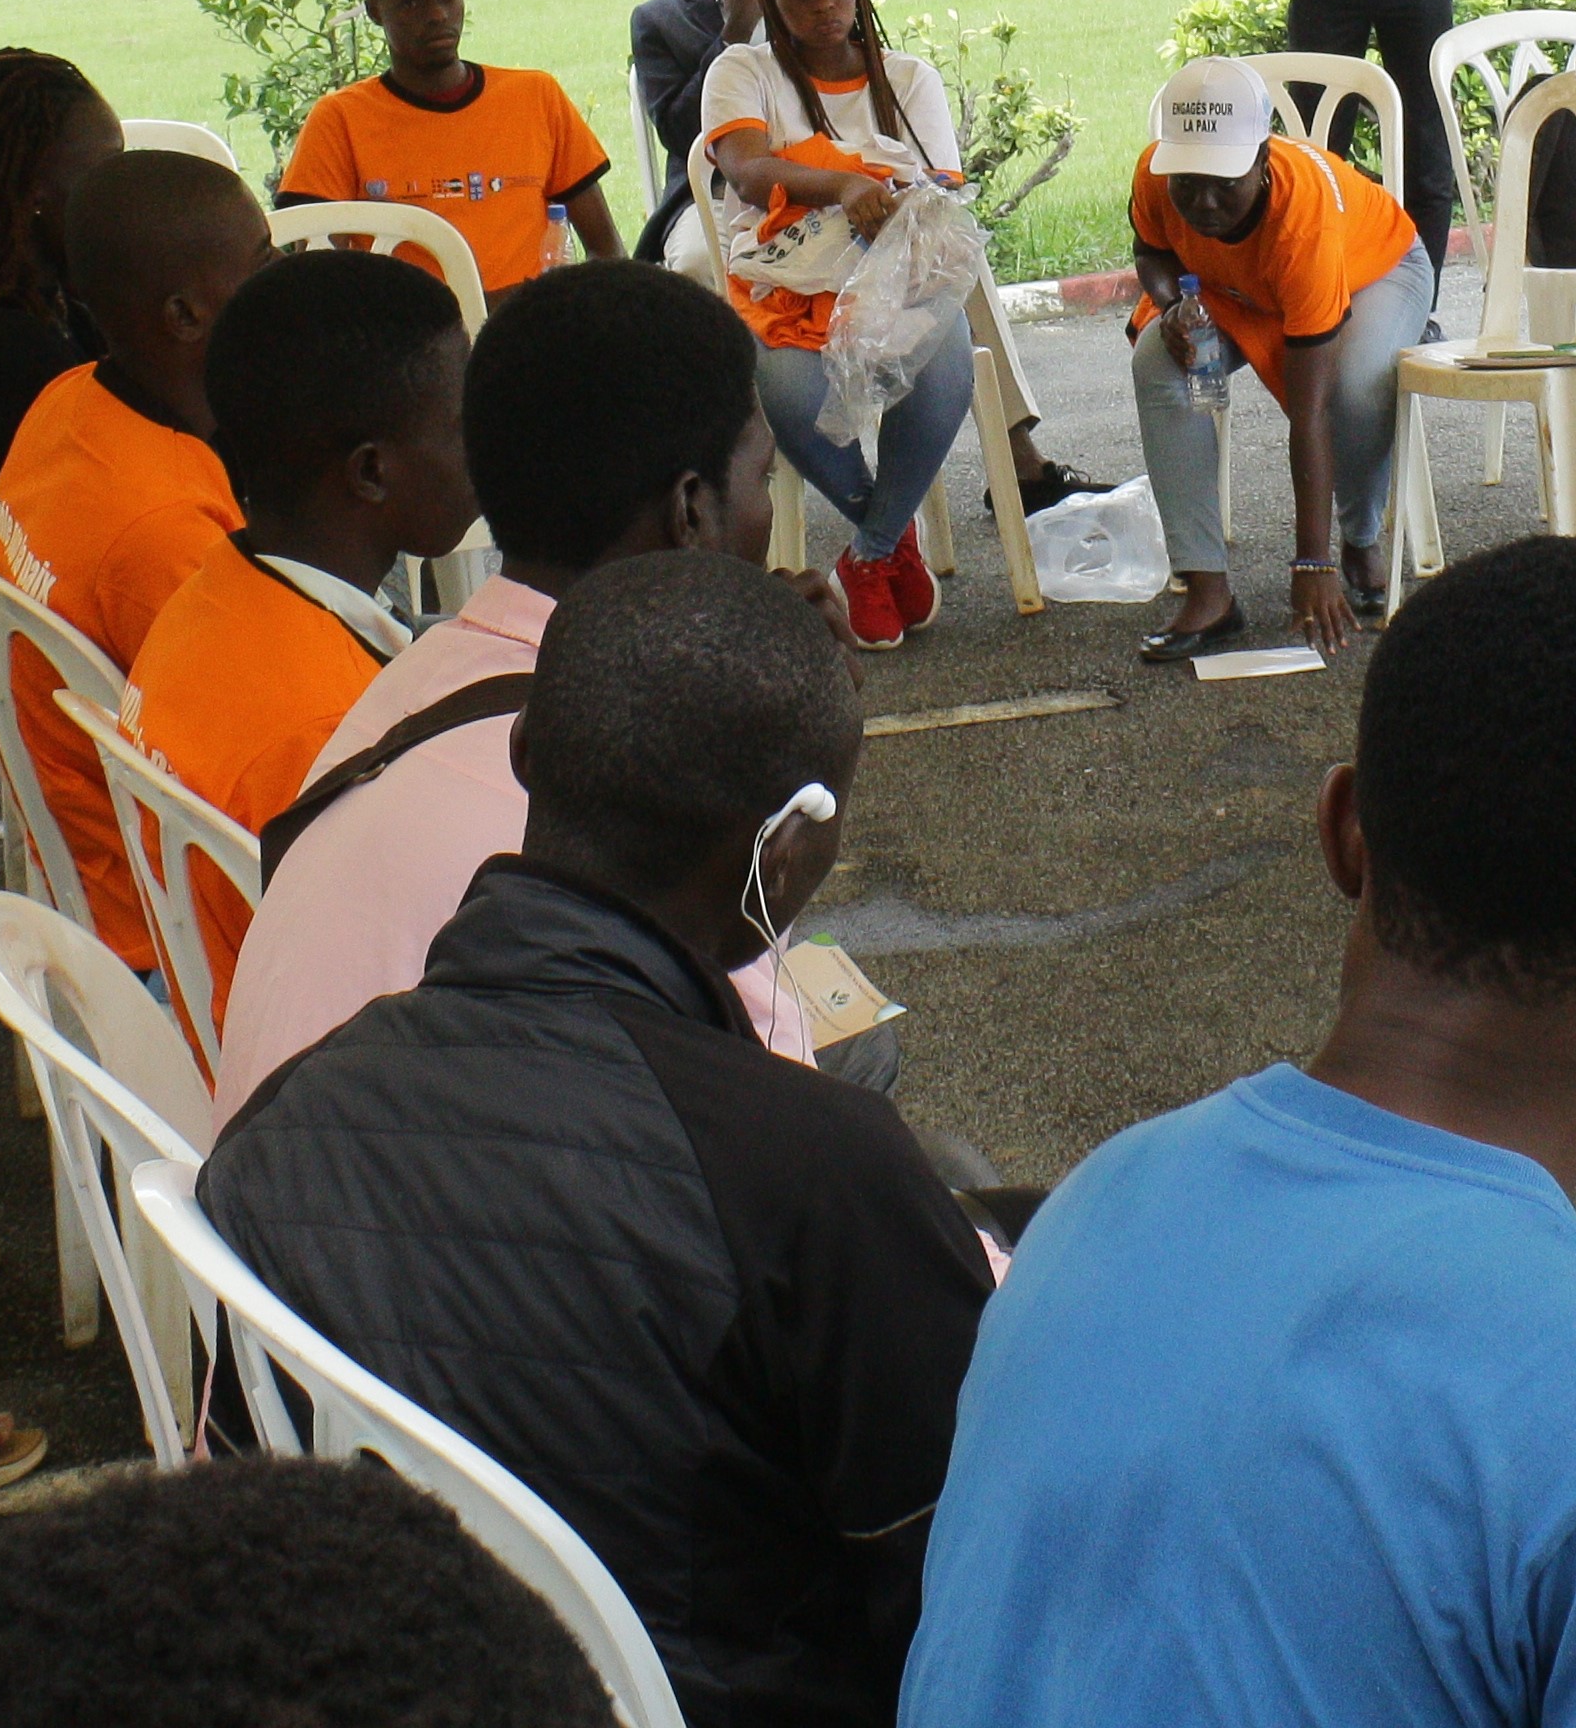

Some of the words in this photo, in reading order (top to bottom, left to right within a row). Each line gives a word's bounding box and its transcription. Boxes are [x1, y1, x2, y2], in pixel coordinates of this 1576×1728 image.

[1172, 99, 1207, 116] ENGAGÉS
[1209, 103, 1233, 116] POUR
[1183, 120, 1193, 132] LA
[1196, 120, 1218, 133] PAIX
